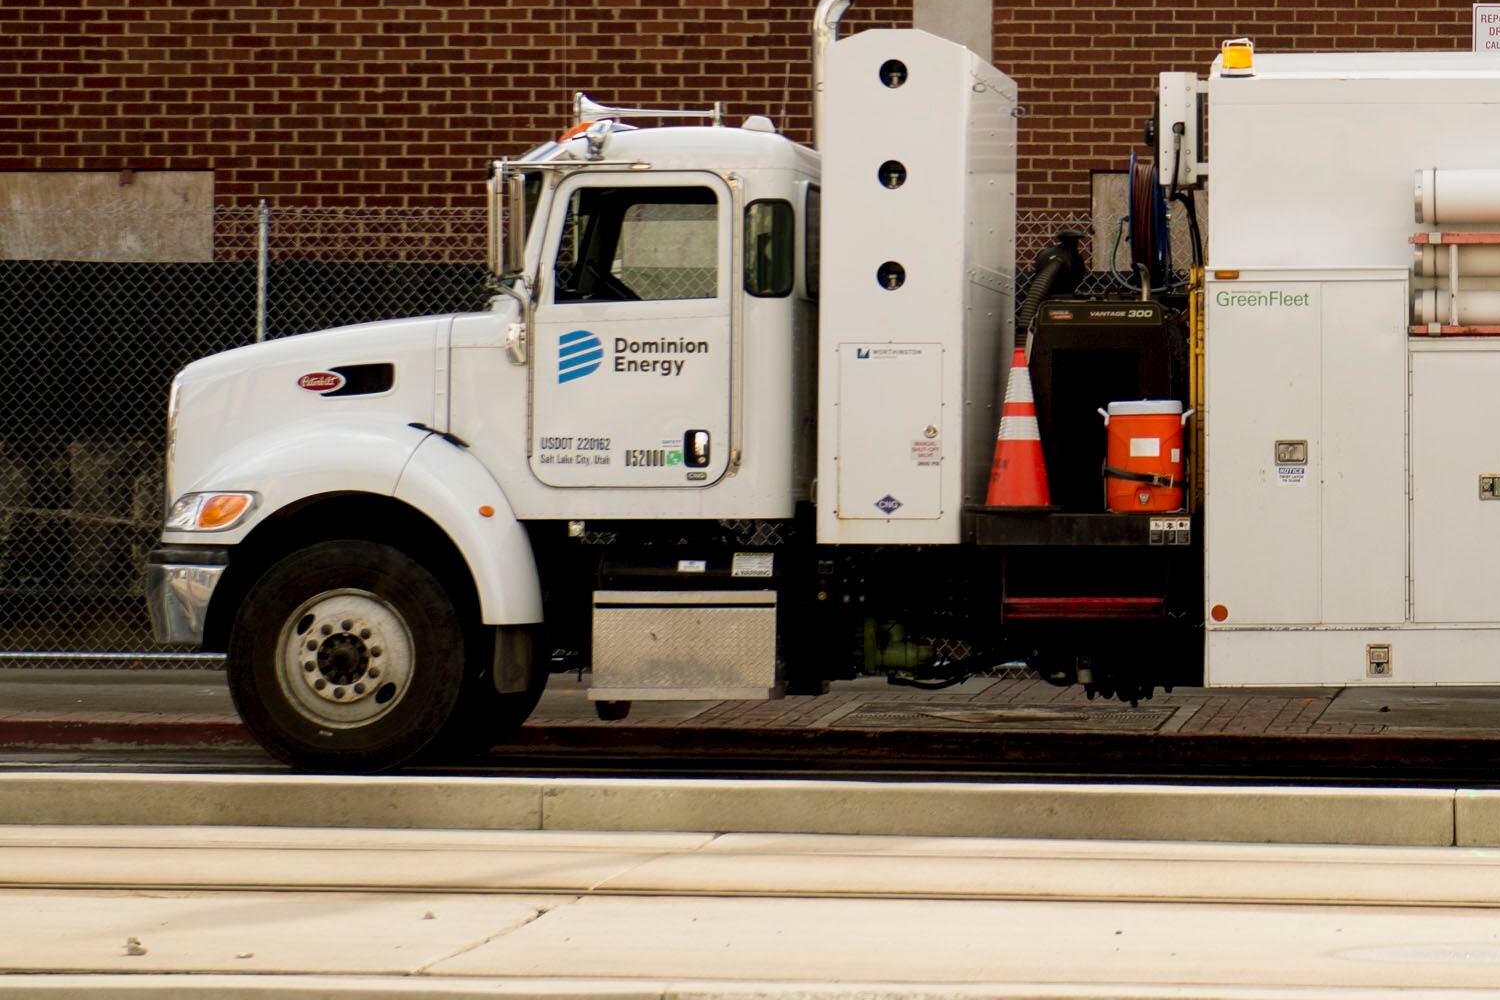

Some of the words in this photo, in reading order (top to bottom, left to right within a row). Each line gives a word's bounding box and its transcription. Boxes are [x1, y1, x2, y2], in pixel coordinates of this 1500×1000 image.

[1216, 290, 1309, 307] GreenFleet
[1128, 310, 1153, 318] 300
[614, 337, 709, 353] Dominion
[614, 356, 685, 376] Energy
[540, 437, 573, 449] USDOT
[540, 454, 554, 464] Salt
[557, 454, 573, 464] Lake
